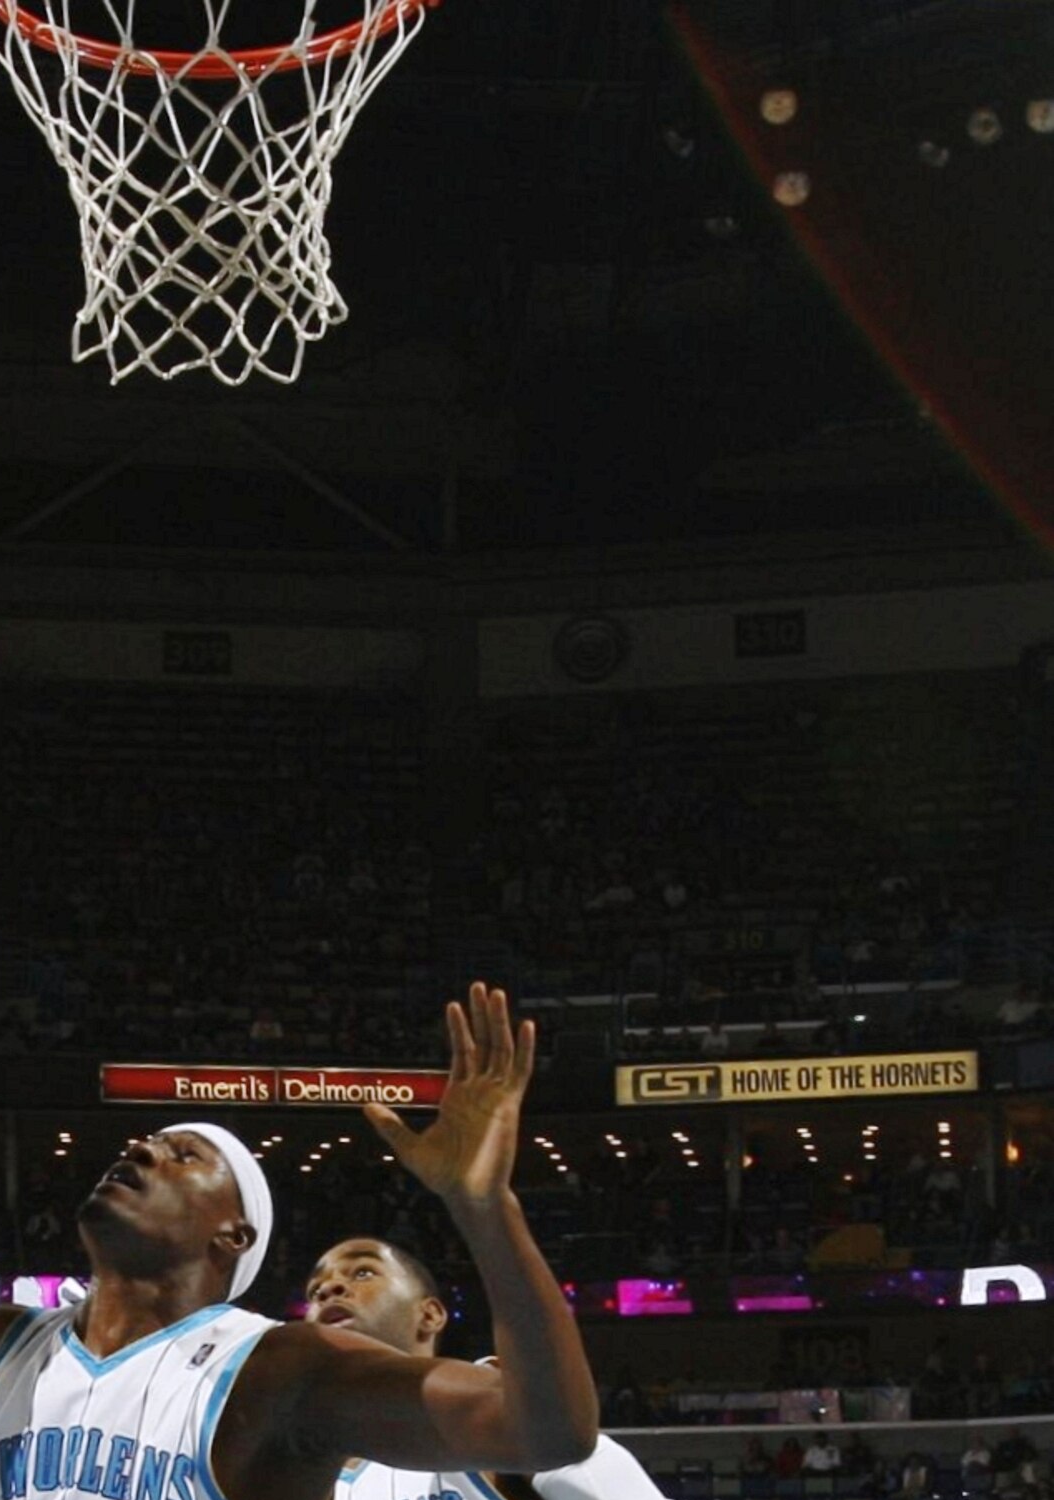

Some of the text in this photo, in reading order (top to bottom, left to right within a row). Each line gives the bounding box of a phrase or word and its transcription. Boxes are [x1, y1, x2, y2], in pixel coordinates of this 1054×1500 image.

[175, 1074, 413, 1102] Emeril's Delmonico
[639, 1060, 966, 1097] CST HOME OF THE HORNETS
